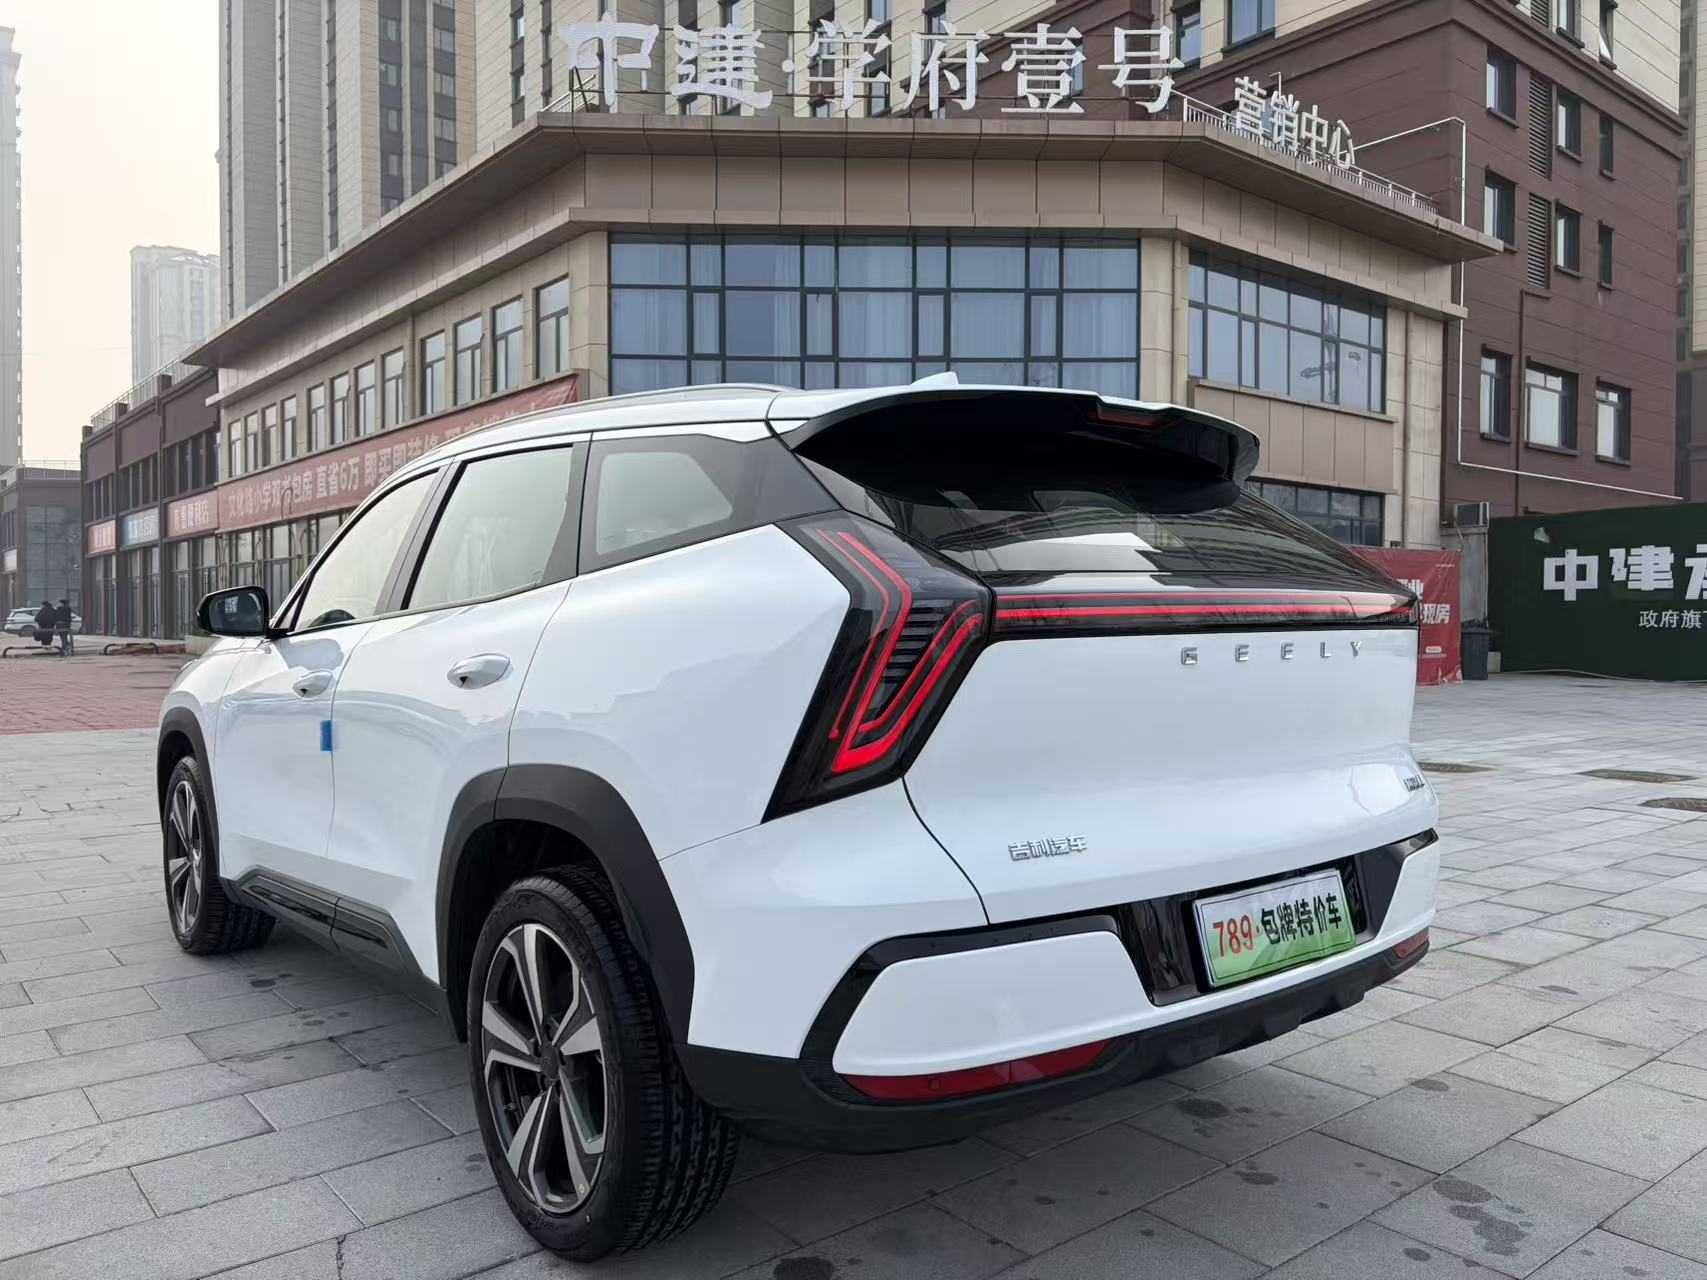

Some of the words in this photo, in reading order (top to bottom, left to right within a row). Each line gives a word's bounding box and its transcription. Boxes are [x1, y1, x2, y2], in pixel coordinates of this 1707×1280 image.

[1234, 76, 1355, 170] 营销中心
[1419, 602, 1451, 626] 现房
[1638, 609, 1707, 630] 政府旗
[1180, 640, 1363, 665] GEELY
[1008, 834, 1088, 862] 吉利汽车
